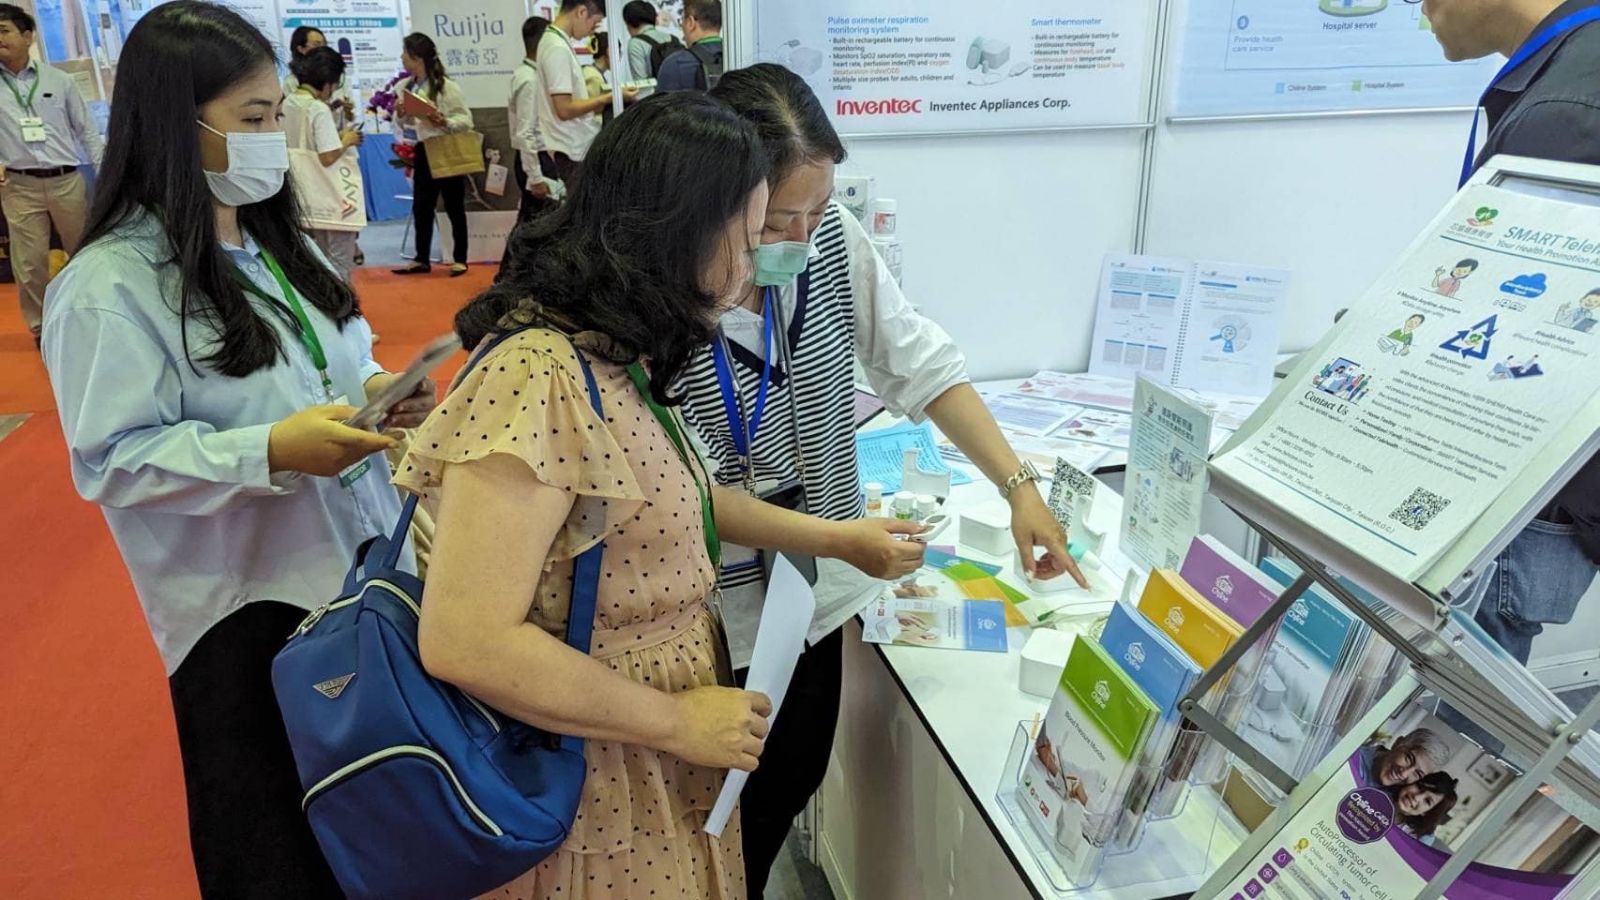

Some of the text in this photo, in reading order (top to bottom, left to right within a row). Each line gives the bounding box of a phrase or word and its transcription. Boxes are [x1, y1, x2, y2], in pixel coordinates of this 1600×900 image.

[434, 12, 504, 44] Ruijia
[828, 16, 928, 26] Pulse oximeter respiration
[828, 25, 899, 36] monitoring system
[1055, 18, 1102, 26] thermometer
[1323, 22, 1352, 31] Hospital
[836, 98, 922, 116] Inventec
[930, 98, 1071, 112] Inventec Appliances Corp.
[1504, 226, 1564, 246] SMART
[1515, 244, 1544, 254] Health
[1543, 249, 1589, 264] Promotion
[1303, 390, 1338, 409] Contact
[1334, 404, 1351, 415] Us
[1306, 826, 1349, 866] Circulating
[1345, 862, 1372, 887] Tumor
[1314, 819, 1377, 877] AutoProcessor of
